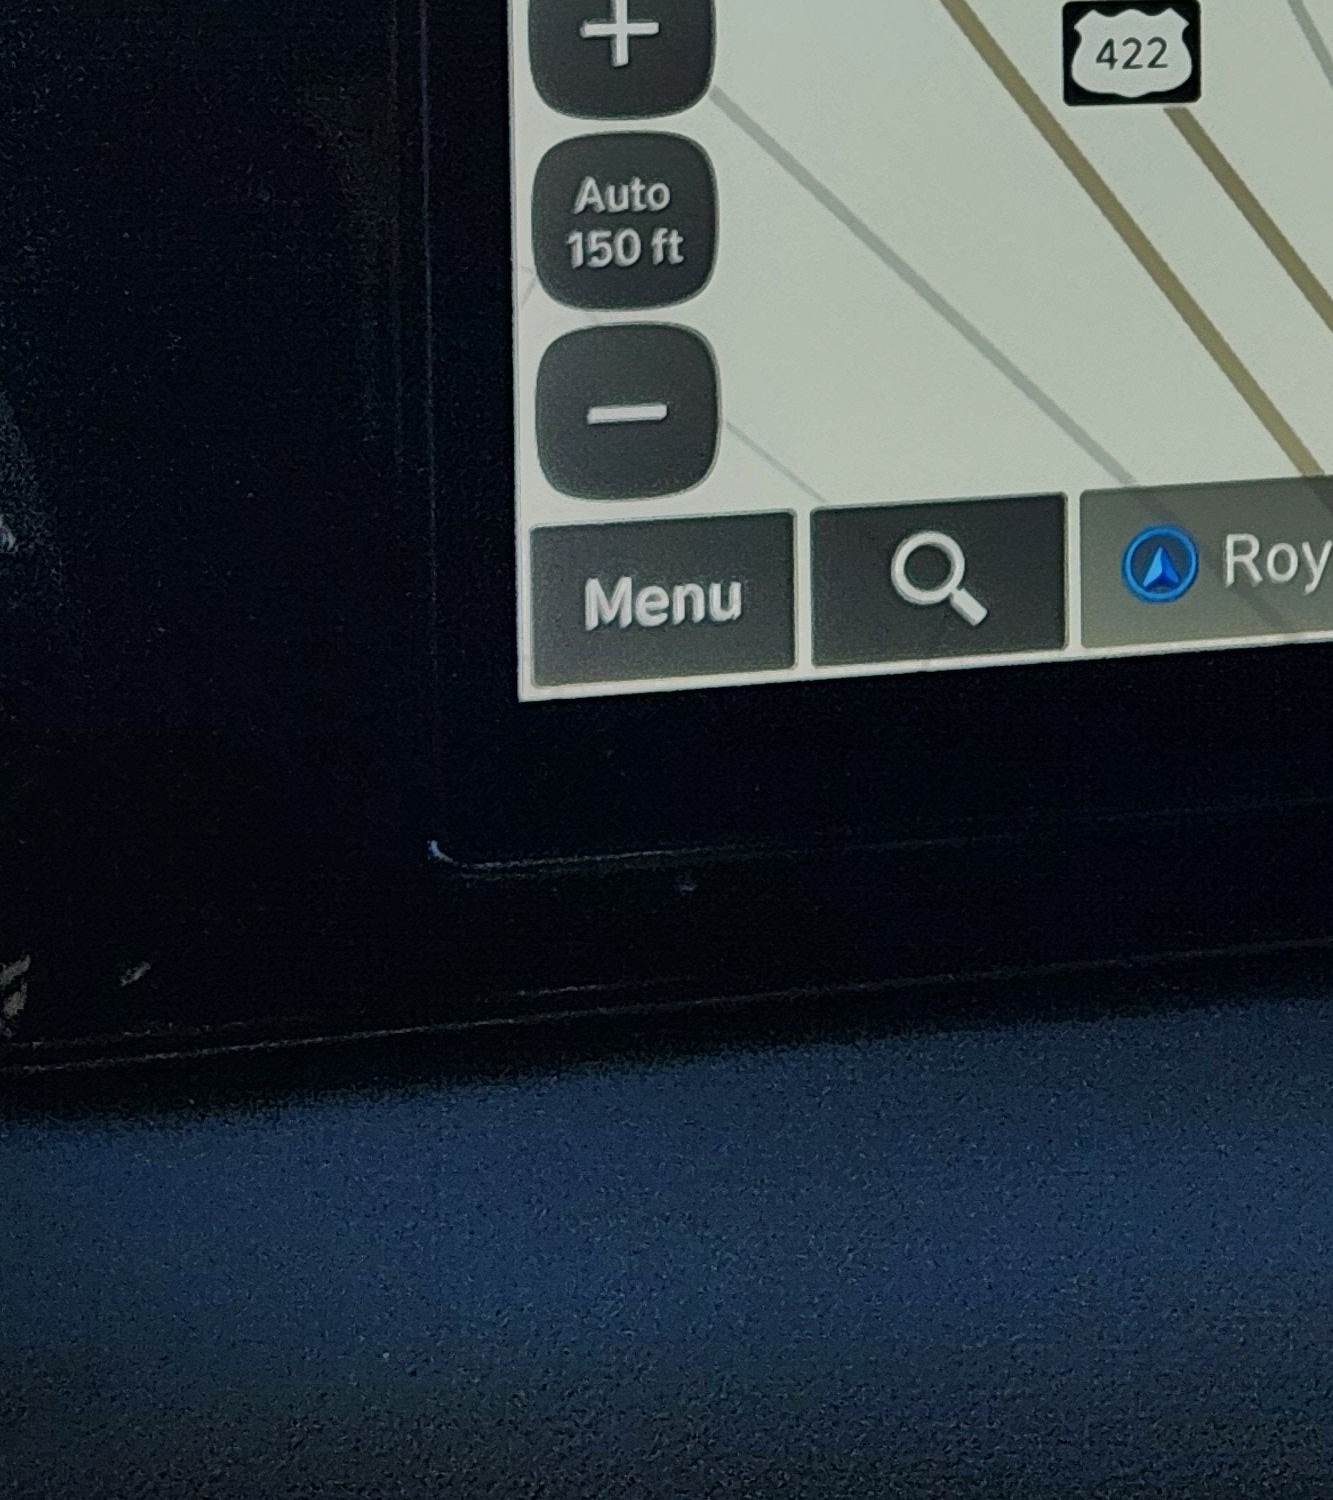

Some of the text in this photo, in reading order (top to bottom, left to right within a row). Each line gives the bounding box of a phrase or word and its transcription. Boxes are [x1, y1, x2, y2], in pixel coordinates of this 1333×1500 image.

[1095, 35, 1169, 71] 422
[574, 176, 671, 213] Auto
[566, 228, 685, 268] 150 ft
[582, 575, 744, 631] Menu
